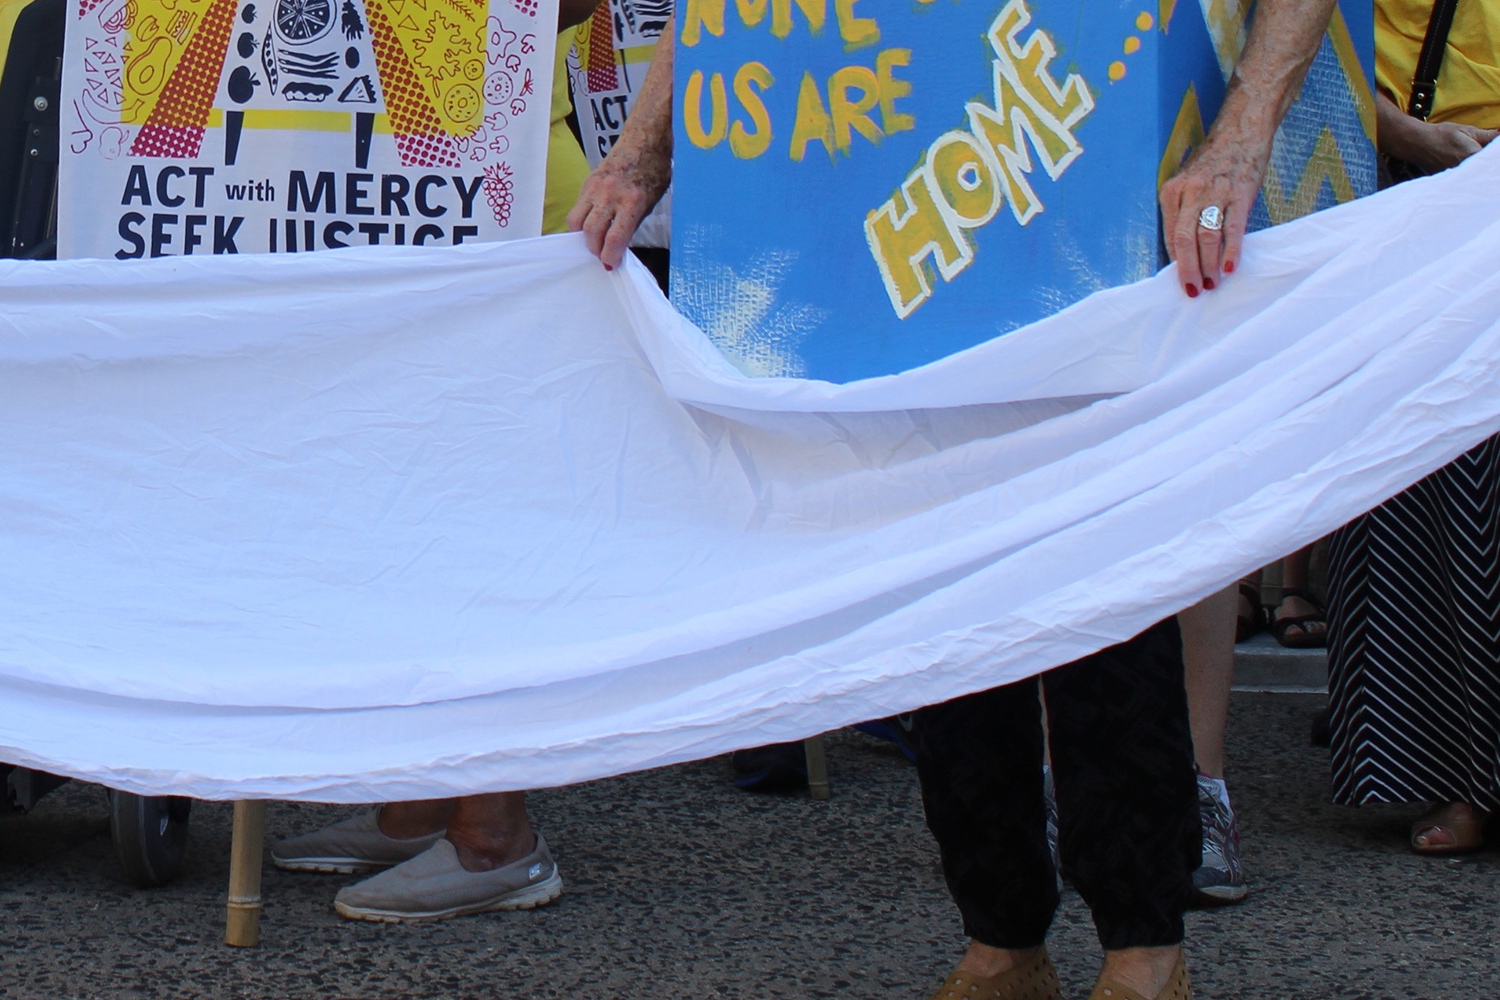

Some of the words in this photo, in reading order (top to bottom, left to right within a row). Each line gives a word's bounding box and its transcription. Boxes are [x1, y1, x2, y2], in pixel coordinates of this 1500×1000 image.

[590, 95, 628, 131] ACT
[683, 61, 775, 160] US
[788, 48, 915, 163] ARE
[121, 165, 215, 208] ACT
[225, 179, 275, 202] with
[287, 170, 484, 218] MERCY
[115, 212, 245, 260] SEEK
